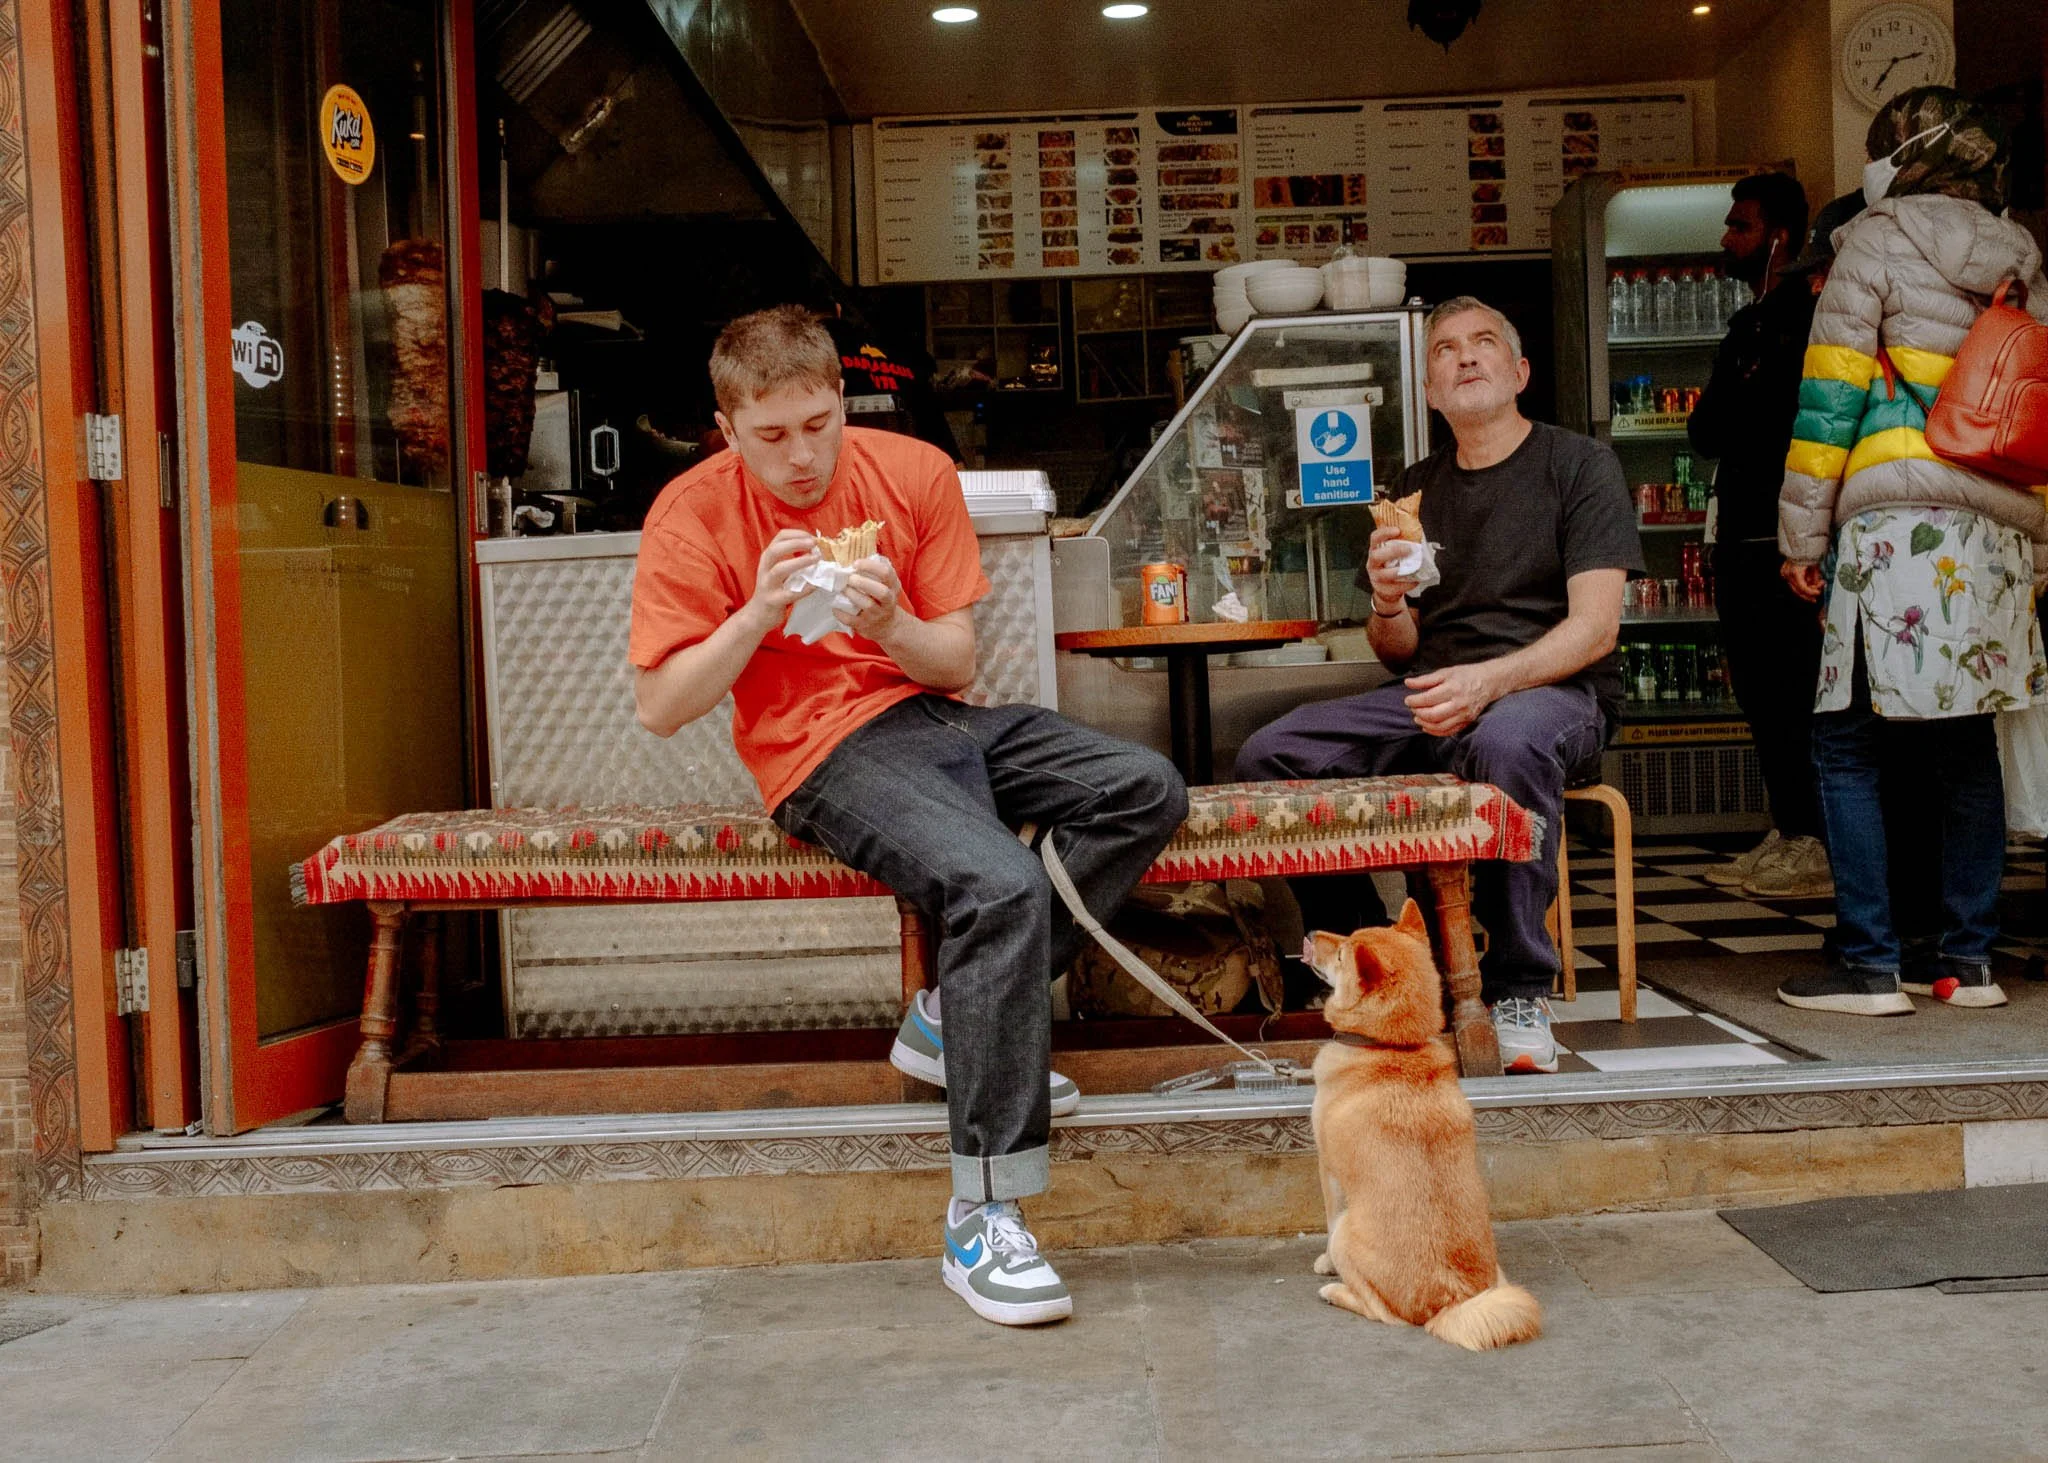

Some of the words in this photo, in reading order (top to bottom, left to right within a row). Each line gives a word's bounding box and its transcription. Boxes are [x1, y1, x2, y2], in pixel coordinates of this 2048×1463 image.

[1888, 21, 1900, 31] 12
[1908, 25, 1914, 35] 1
[1871, 27, 1883, 37] 11
[1922, 36, 1928, 46] 2
[1860, 42, 1872, 52] 10
[1855, 59, 1862, 68] 9
[1928, 54, 1934, 63] 3
[1862, 77, 1868, 86] 8
[1924, 72, 1930, 82] 4
[1635, 417, 1654, 425] PLEASE
[1655, 416, 1669, 424] KEEP
[1325, 465, 1346, 475] Use
[1323, 477, 1350, 487] hand
[1314, 490, 1360, 500] sanitiser
[1648, 728, 1668, 737] PLEASE
[1669, 728, 1683, 736] KEEP
